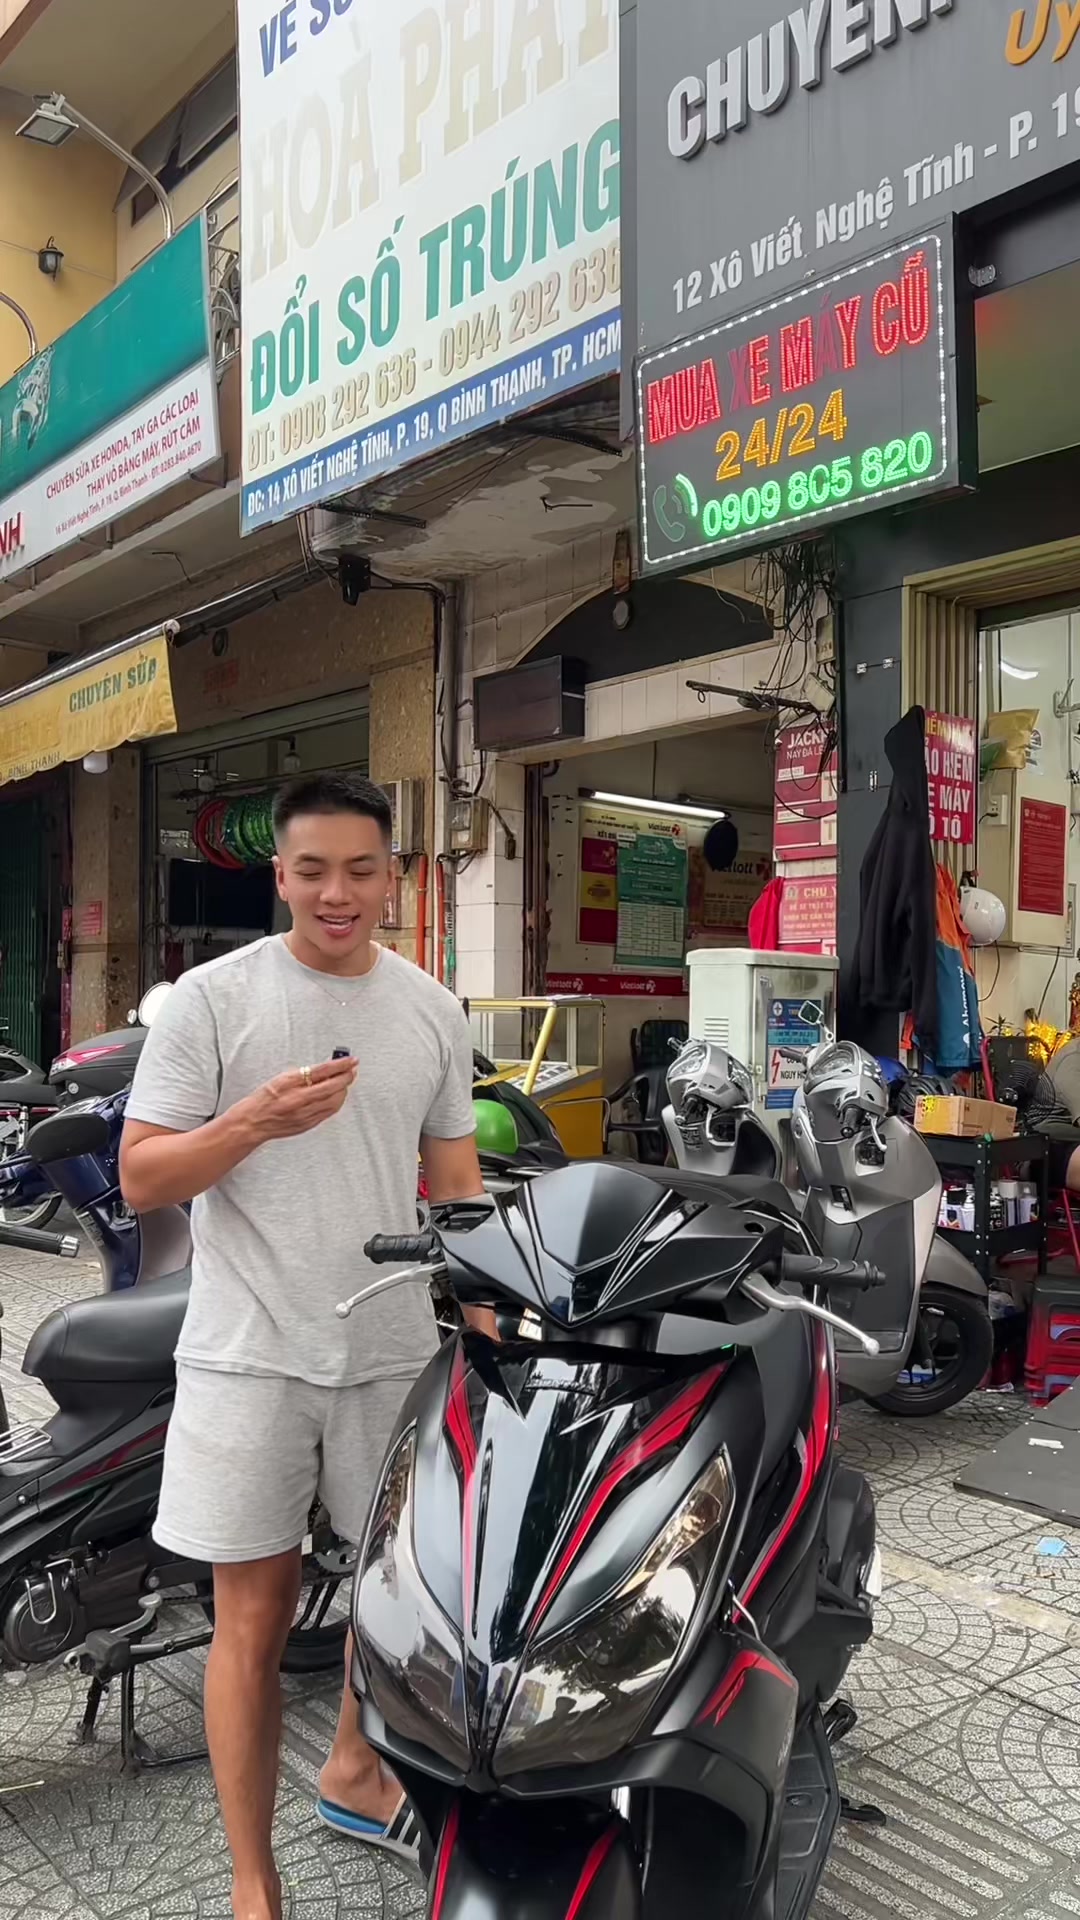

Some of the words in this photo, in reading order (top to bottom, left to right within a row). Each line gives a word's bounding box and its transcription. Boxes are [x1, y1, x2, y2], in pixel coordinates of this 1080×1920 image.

[673, 270, 702, 314] 12
[709, 250, 743, 299] Xô
[750, 216, 803, 278] Viết
[815, 177, 894, 249] Nghệ
[904, 142, 974, 207] Tĩnh
[1010, 110, 1038, 159] P.
[1052, 86, 1080, 138] 1
[250, 274, 320, 415] ĐỔI
[337, 215, 405, 366] SỐ
[419, 118, 620, 321] TRÚNG
[248, 427, 277, 472] ĐT:
[280, 395, 327, 455] 0908
[331, 372, 370, 431] 292
[375, 347, 417, 405] 636
[439, 303, 502, 379] 0944
[509, 271, 561, 342] 292
[568, 238, 620, 312] 636
[648, 357, 721, 444] MUA
[727, 335, 772, 415] XE
[780, 291, 862, 393] MÁY
[871, 250, 929, 356] CŨ
[131, 424, 146, 445] TAY
[146, 416, 160, 435] GA
[160, 405, 177, 427] CÁC
[267, 482, 281, 506] 14
[283, 466, 298, 500] XÔ
[299, 459, 324, 494] VIẾT
[326, 441, 359, 479] NGHỆ
[360, 433, 394, 472] TĨNH,
[397, 430, 411, 452] P.
[413, 414, 434, 443] 19,
[437, 405, 448, 433] Q
[451, 388, 487, 426] BÌNH
[490, 364, 546, 405] THẠNH,
[551, 346, 577, 380] TP.
[582, 320, 621, 365] HCM
[715, 388, 848, 482] 24/24
[87, 475, 106, 498] THAY
[702, 480, 781, 537] 0909
[788, 456, 854, 511] 805
[860, 430, 934, 489] 820
[940, 782, 971, 814] MÁY
[942, 815, 962, 839] TÔ
[780, 1070, 796, 1080] NGUY
